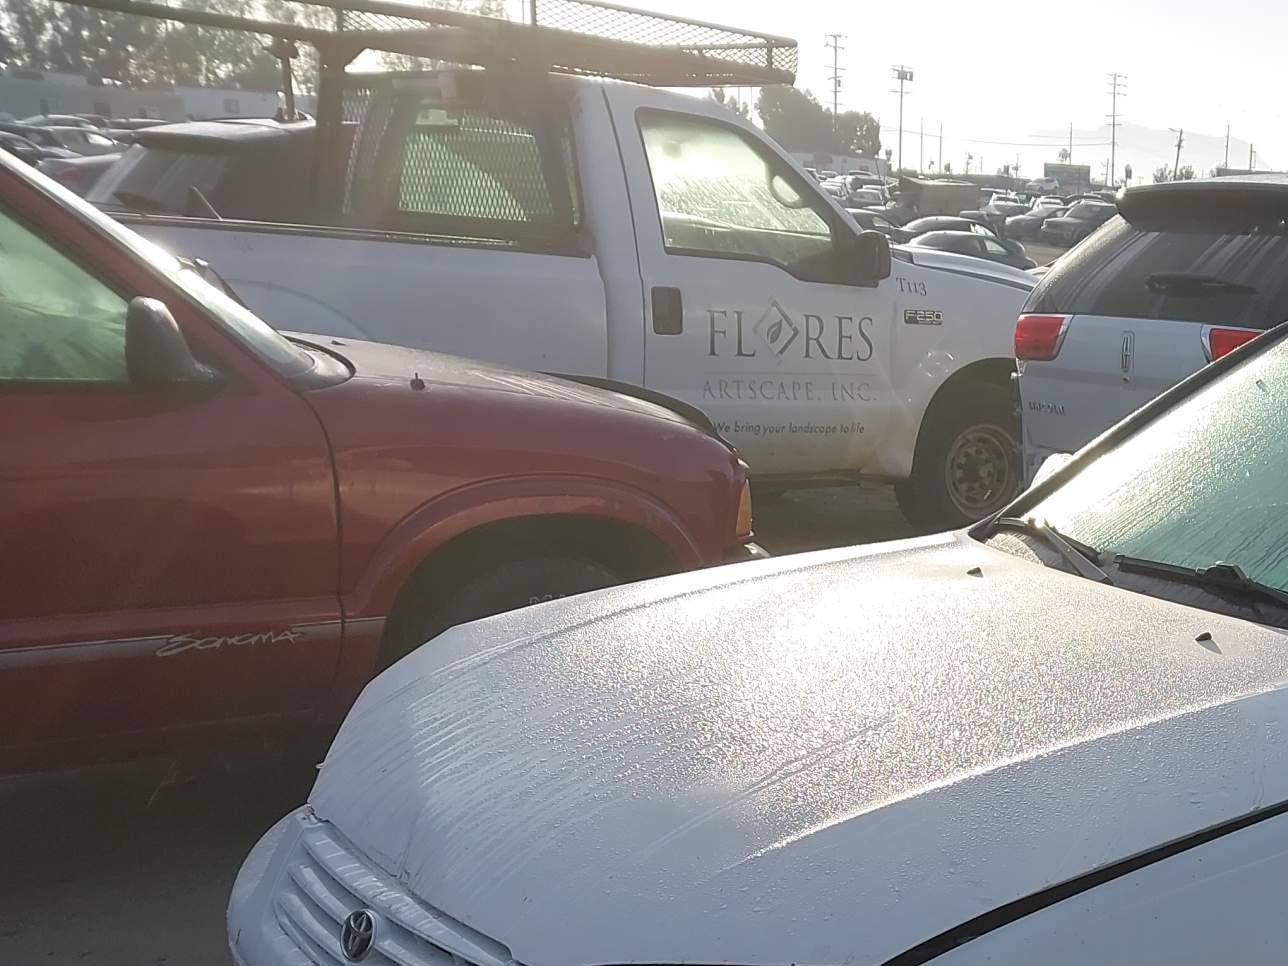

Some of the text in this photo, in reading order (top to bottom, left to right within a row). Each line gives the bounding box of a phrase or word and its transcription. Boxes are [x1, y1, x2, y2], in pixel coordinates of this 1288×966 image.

[734, 420, 760, 436] bring
[762, 424, 785, 437] your
[788, 421, 837, 436] landscape
[840, 423, 849, 433] to
